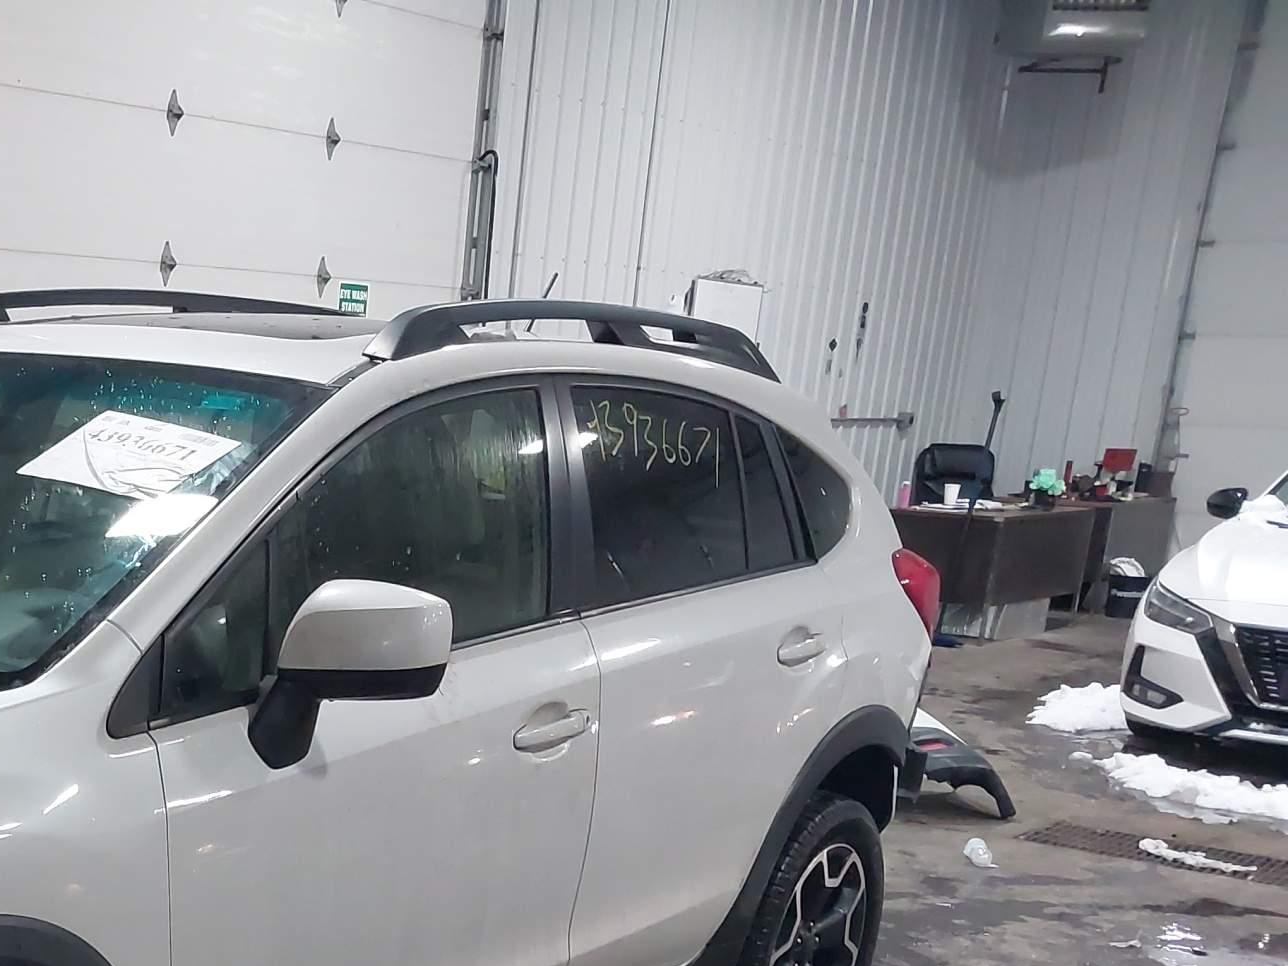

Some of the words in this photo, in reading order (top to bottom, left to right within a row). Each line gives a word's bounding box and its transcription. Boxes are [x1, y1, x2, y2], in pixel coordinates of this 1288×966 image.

[340, 288, 351, 300] EYE
[352, 290, 368, 301] WASH
[341, 301, 365, 313] STATION
